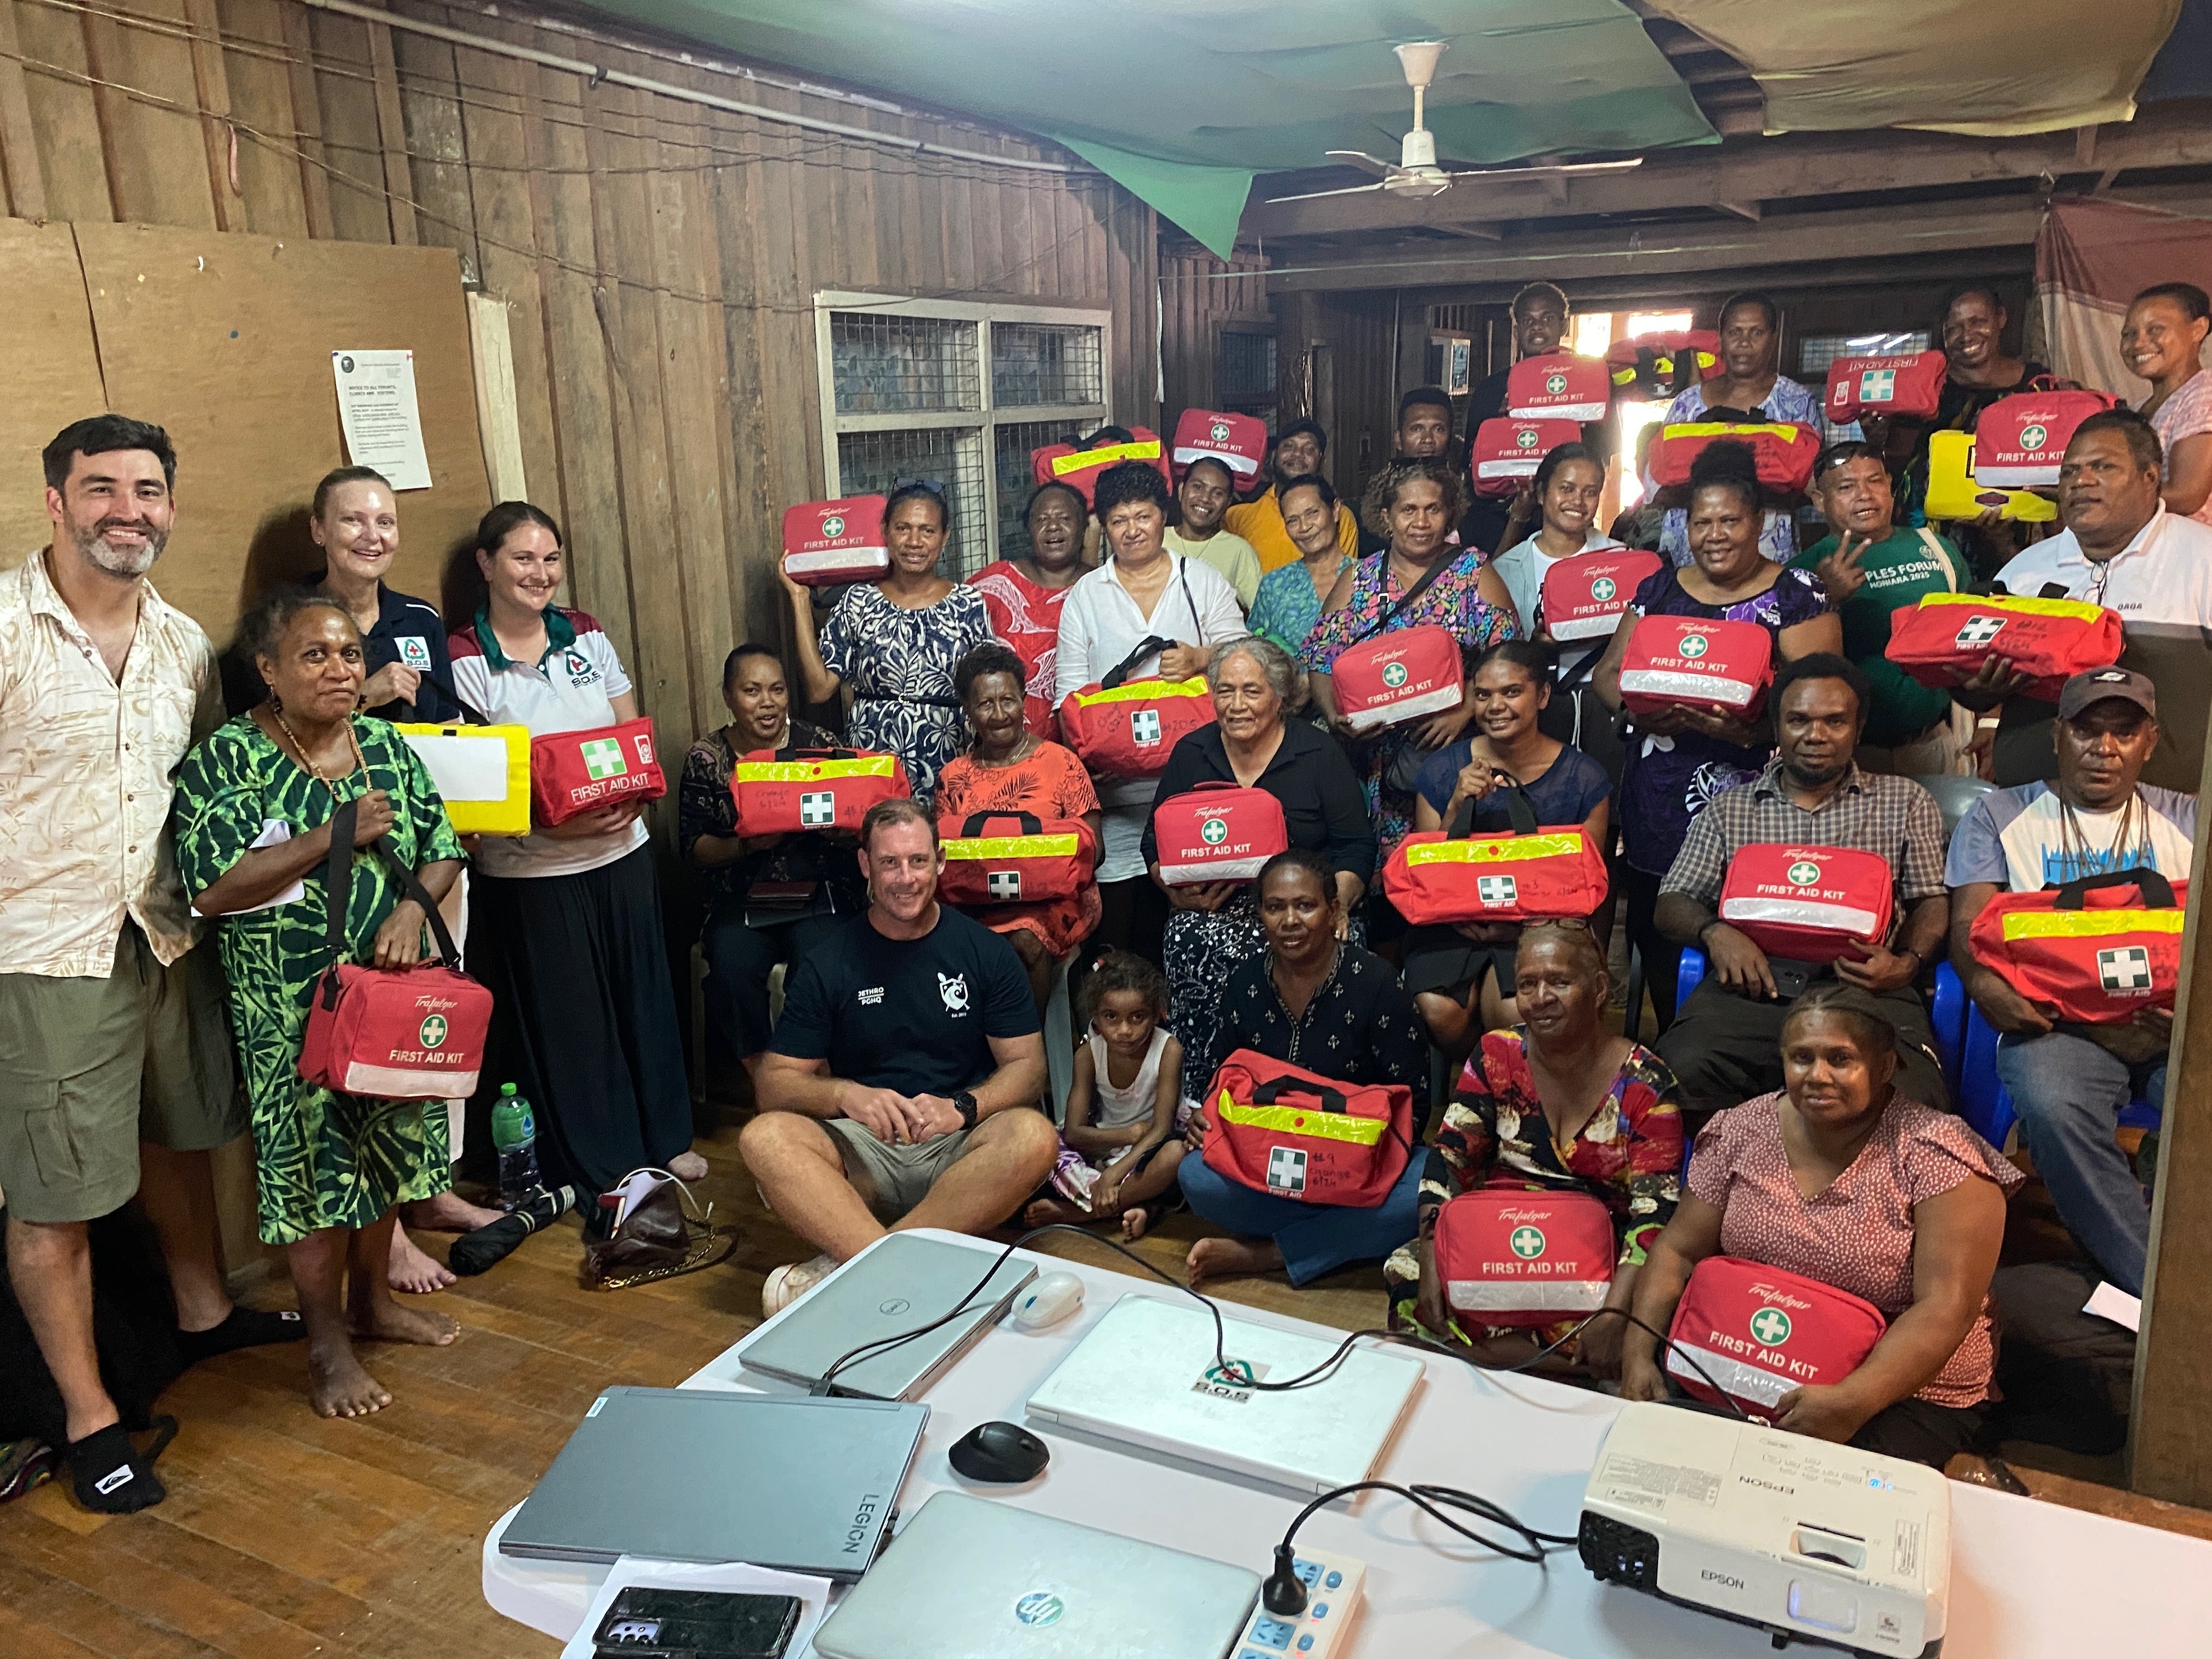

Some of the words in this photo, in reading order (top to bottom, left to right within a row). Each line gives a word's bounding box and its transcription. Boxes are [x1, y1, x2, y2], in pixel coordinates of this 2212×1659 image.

[1848, 360, 1865, 373] KIT
[1866, 359, 1886, 370] AID
[1885, 358, 1919, 369] FIRST
[1529, 396, 1553, 404] FIRST
[1554, 394, 1568, 403] AID
[1571, 393, 1584, 401] KIT
[1193, 439, 1215, 448] FIRST
[1230, 444, 1243, 453] KIT
[1996, 453, 2025, 462] FIRST
[2028, 452, 2045, 461] AID
[2049, 450, 2066, 461] KIT
[804, 540, 830, 549] FIRST
[832, 538, 847, 546] AID
[849, 537, 864, 545] KIT
[1869, 576, 1909, 589] HONIARA
[1910, 571, 1930, 582] 2025
[1573, 603, 1601, 616] FIRST
[1604, 601, 1621, 611] AID
[1650, 657, 1684, 668] FIRST
[1685, 660, 1706, 670] AID
[1708, 663, 1728, 674] KIT
[1367, 690, 1396, 706] FIRST
[1398, 685, 1415, 697] AID
[1416, 679, 1432, 691] KIT
[571, 781, 606, 802] FIRST
[610, 777, 629, 792] AID
[631, 772, 648, 787] KIT
[1194, 806, 1233, 820] Trafalgar
[1181, 847, 1211, 858] FIRST
[1213, 845, 1231, 856] AID
[1234, 843, 1251, 854] KIT
[1757, 884, 1795, 895] FIRST
[1796, 887, 1820, 898] AID
[1822, 890, 1846, 900] KIT
[415, 995, 458, 1013] Trafalgar
[390, 1049, 424, 1063] FIRST
[425, 1052, 445, 1064] AID
[446, 1053, 465, 1064] KIT
[1268, 1188, 1288, 1196] FIRST
[1499, 1207, 1552, 1224] Trafalgar
[1482, 1262, 1523, 1274] FIRST
[1527, 1262, 1551, 1274] AID
[1555, 1262, 1578, 1274] KIT
[1748, 1282, 1812, 1310] Trafalgar
[1709, 1330, 1756, 1356] FIRST
[1756, 1348, 1786, 1368] AID
[1788, 1358, 1819, 1379] KIT
[1739, 1475, 1795, 1494] EPSON
[842, 1494, 879, 1553] LEGION
[1701, 1568, 1744, 1589] EPSON
